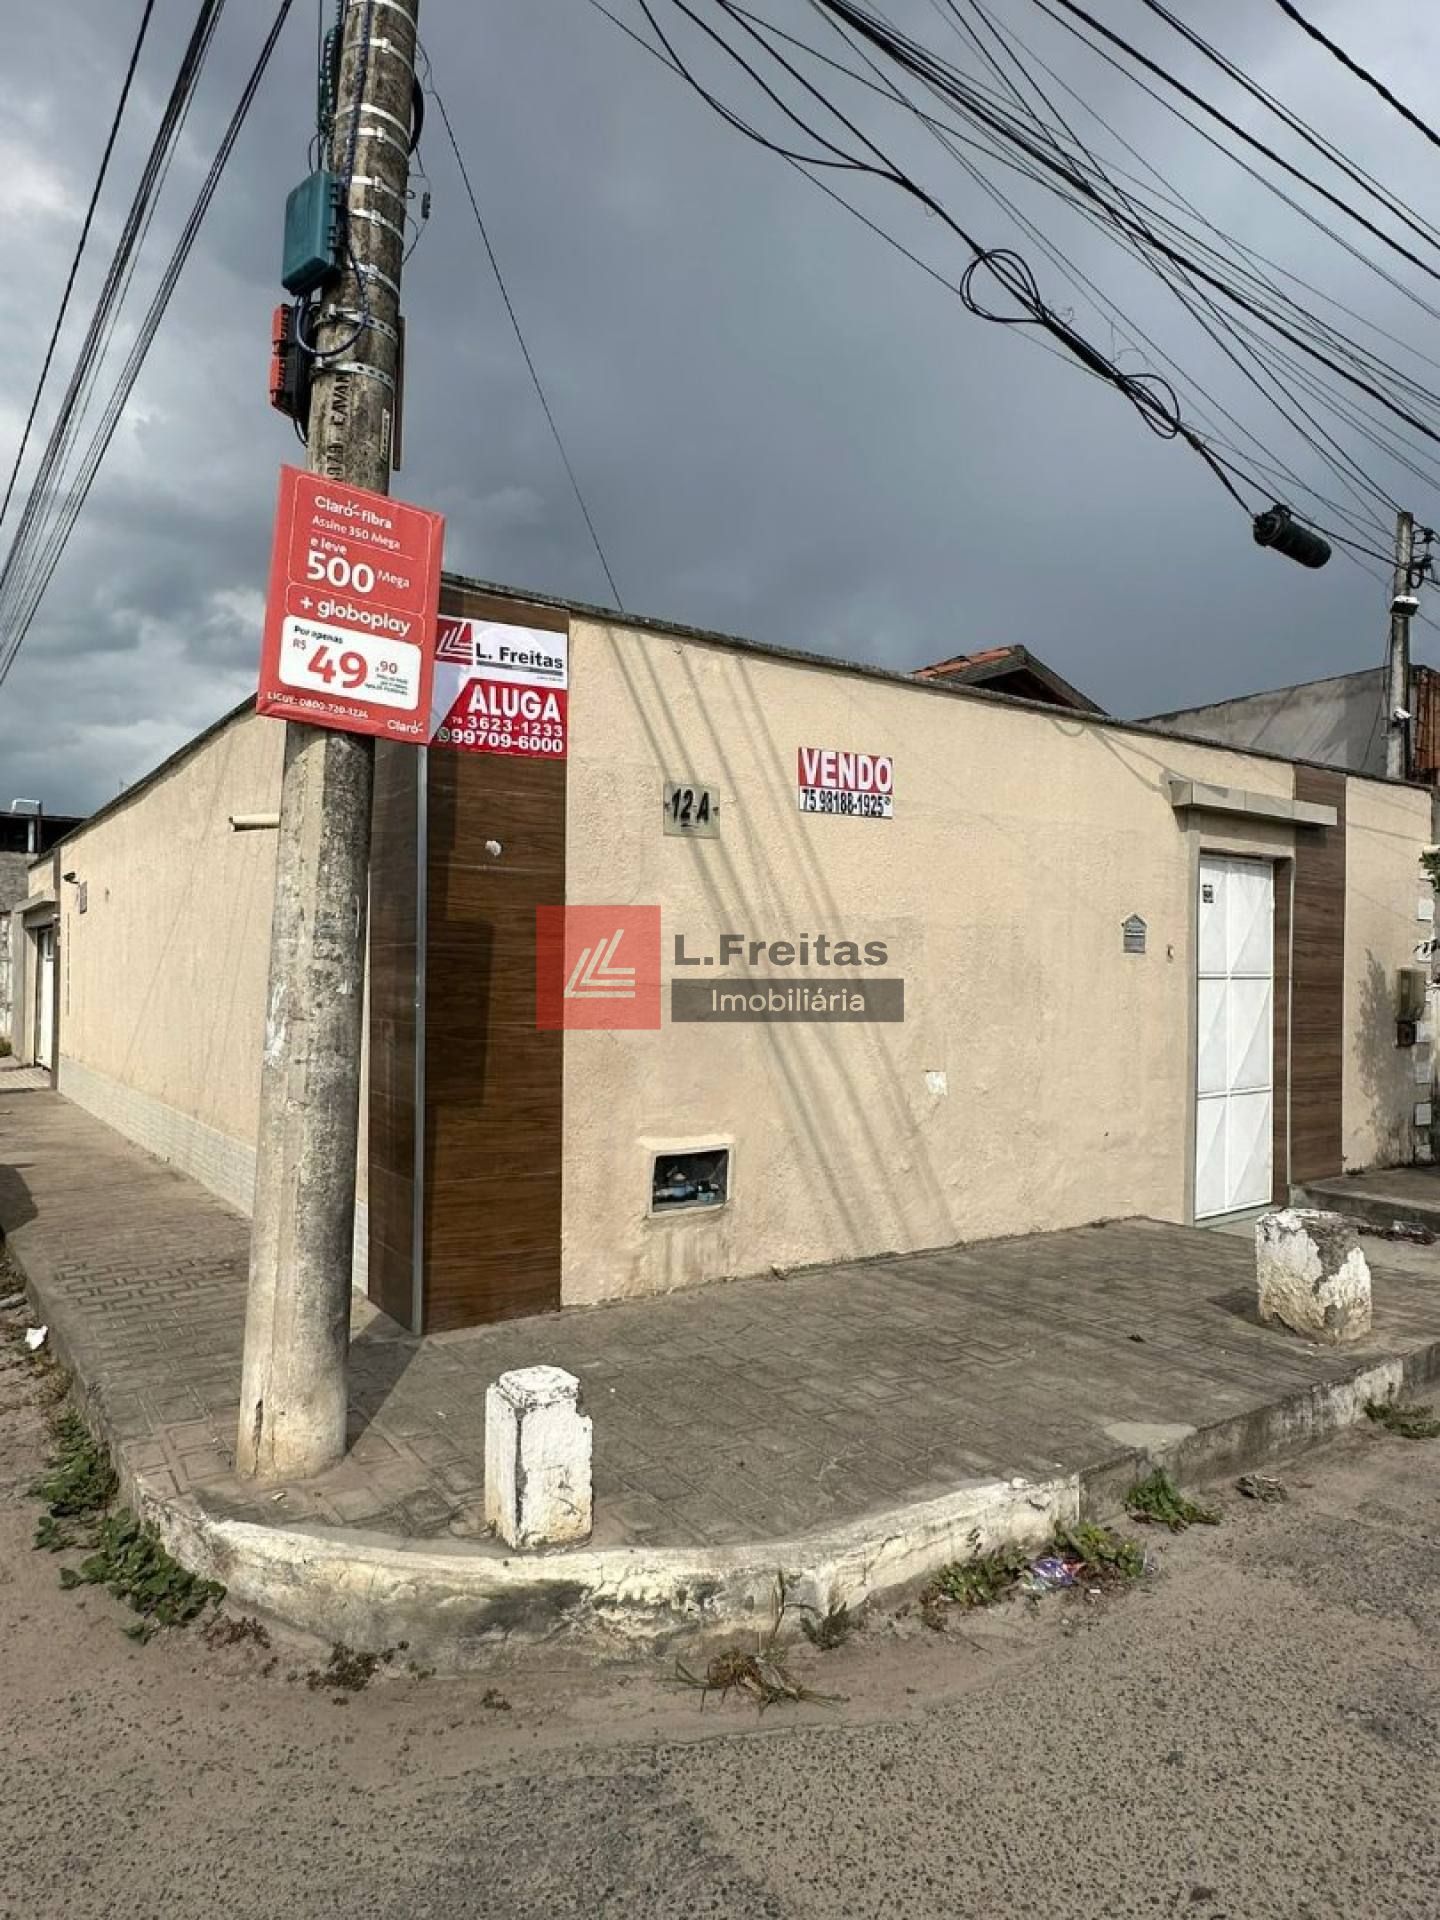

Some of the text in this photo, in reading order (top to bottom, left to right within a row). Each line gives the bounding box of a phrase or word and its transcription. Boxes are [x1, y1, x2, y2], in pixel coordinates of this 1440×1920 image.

[312, 514, 401, 550] Assine 350 Mega
[361, 509, 392, 529] fibra
[310, 536, 348, 555] e leve
[306, 550, 410, 593] 500 Mega
[317, 601, 411, 635] globoplay
[311, 631, 344, 645] apenas
[293, 638, 306, 651] R$
[308, 644, 369, 689] 49
[476, 642, 564, 670] L. Freitas
[467, 683, 562, 724] ALUGA
[387, 719, 421, 734] Claro
[467, 715, 563, 738] 3623-1233
[451, 728, 563, 753] 99709-6000
[801, 747, 893, 793] VENDO
[802, 788, 817, 811] 75
